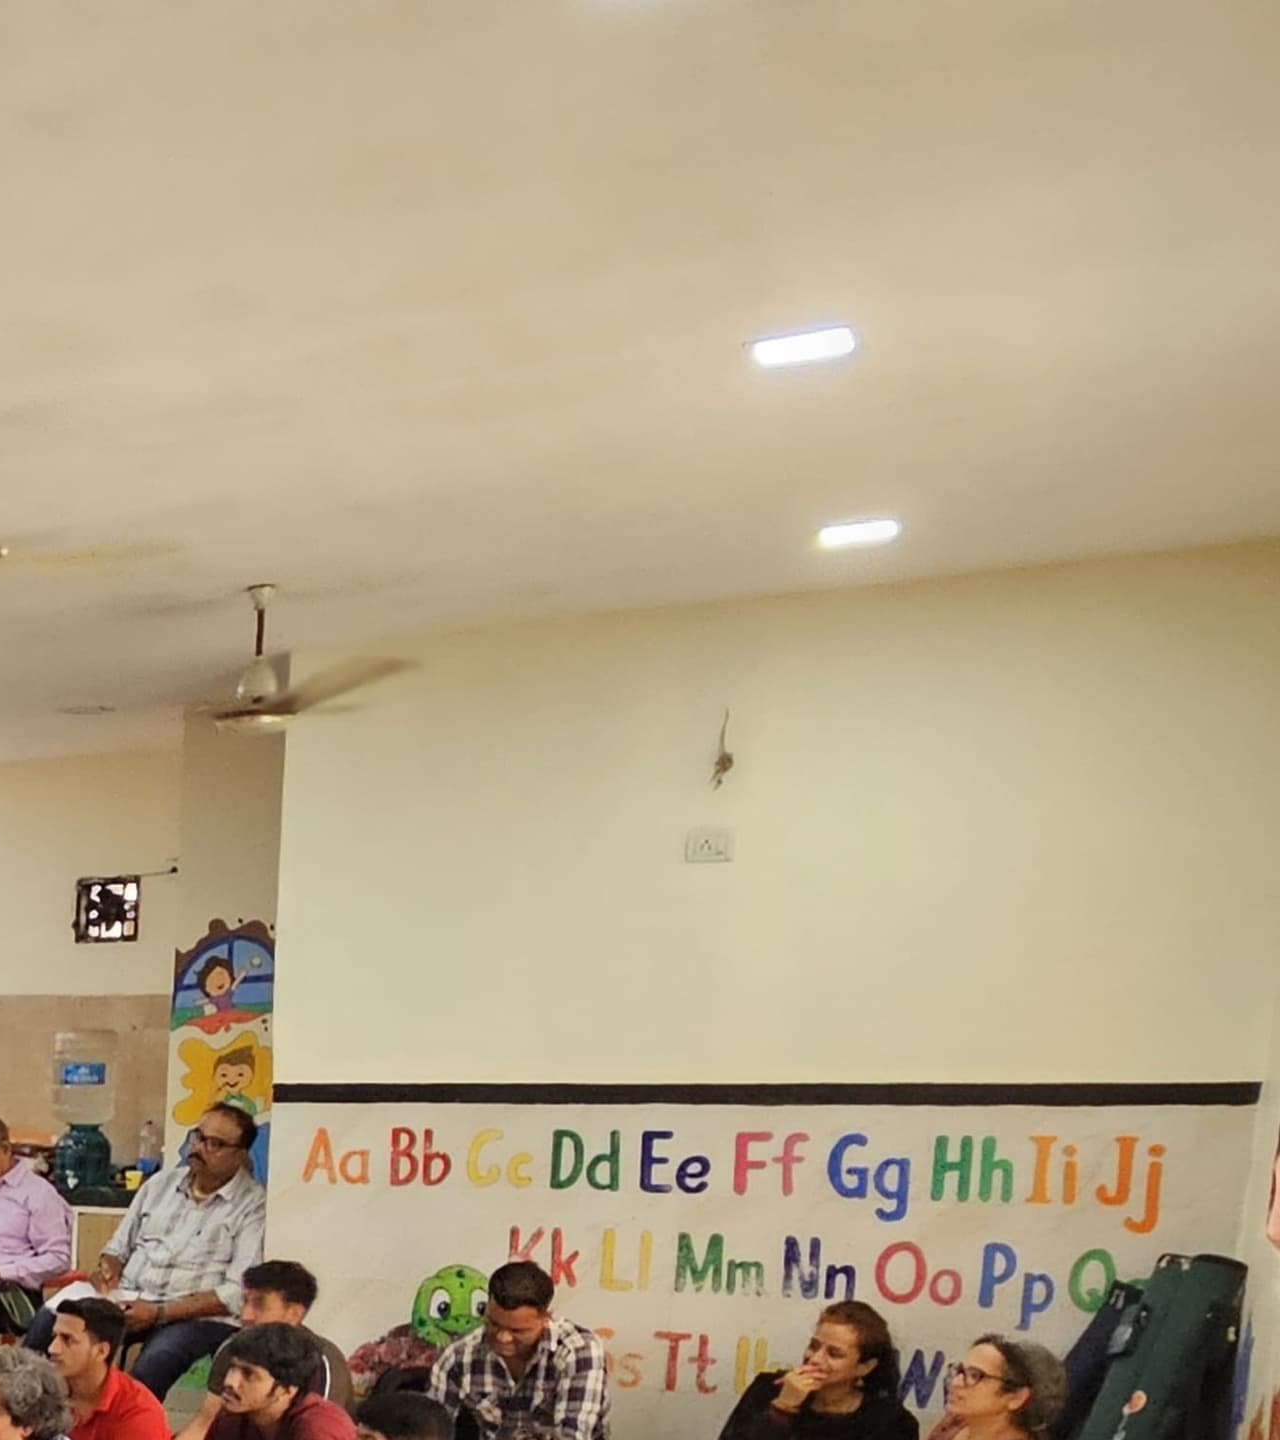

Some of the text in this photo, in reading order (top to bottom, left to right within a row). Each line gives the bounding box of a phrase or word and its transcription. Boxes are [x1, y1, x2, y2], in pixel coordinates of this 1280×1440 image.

[301, 1126, 1166, 1233] Aa Bb Cc Dd Ee Ff Gg Hh Ii Jj
[600, 1228, 653, 1291] Ll
[675, 1231, 764, 1297] Mm
[782, 1235, 856, 1300] Nn
[875, 1241, 962, 1305] Oo
[978, 1242, 1055, 1331] Pp
[1068, 1248, 1152, 1313] Q
[654, 1331, 717, 1395] Tt
